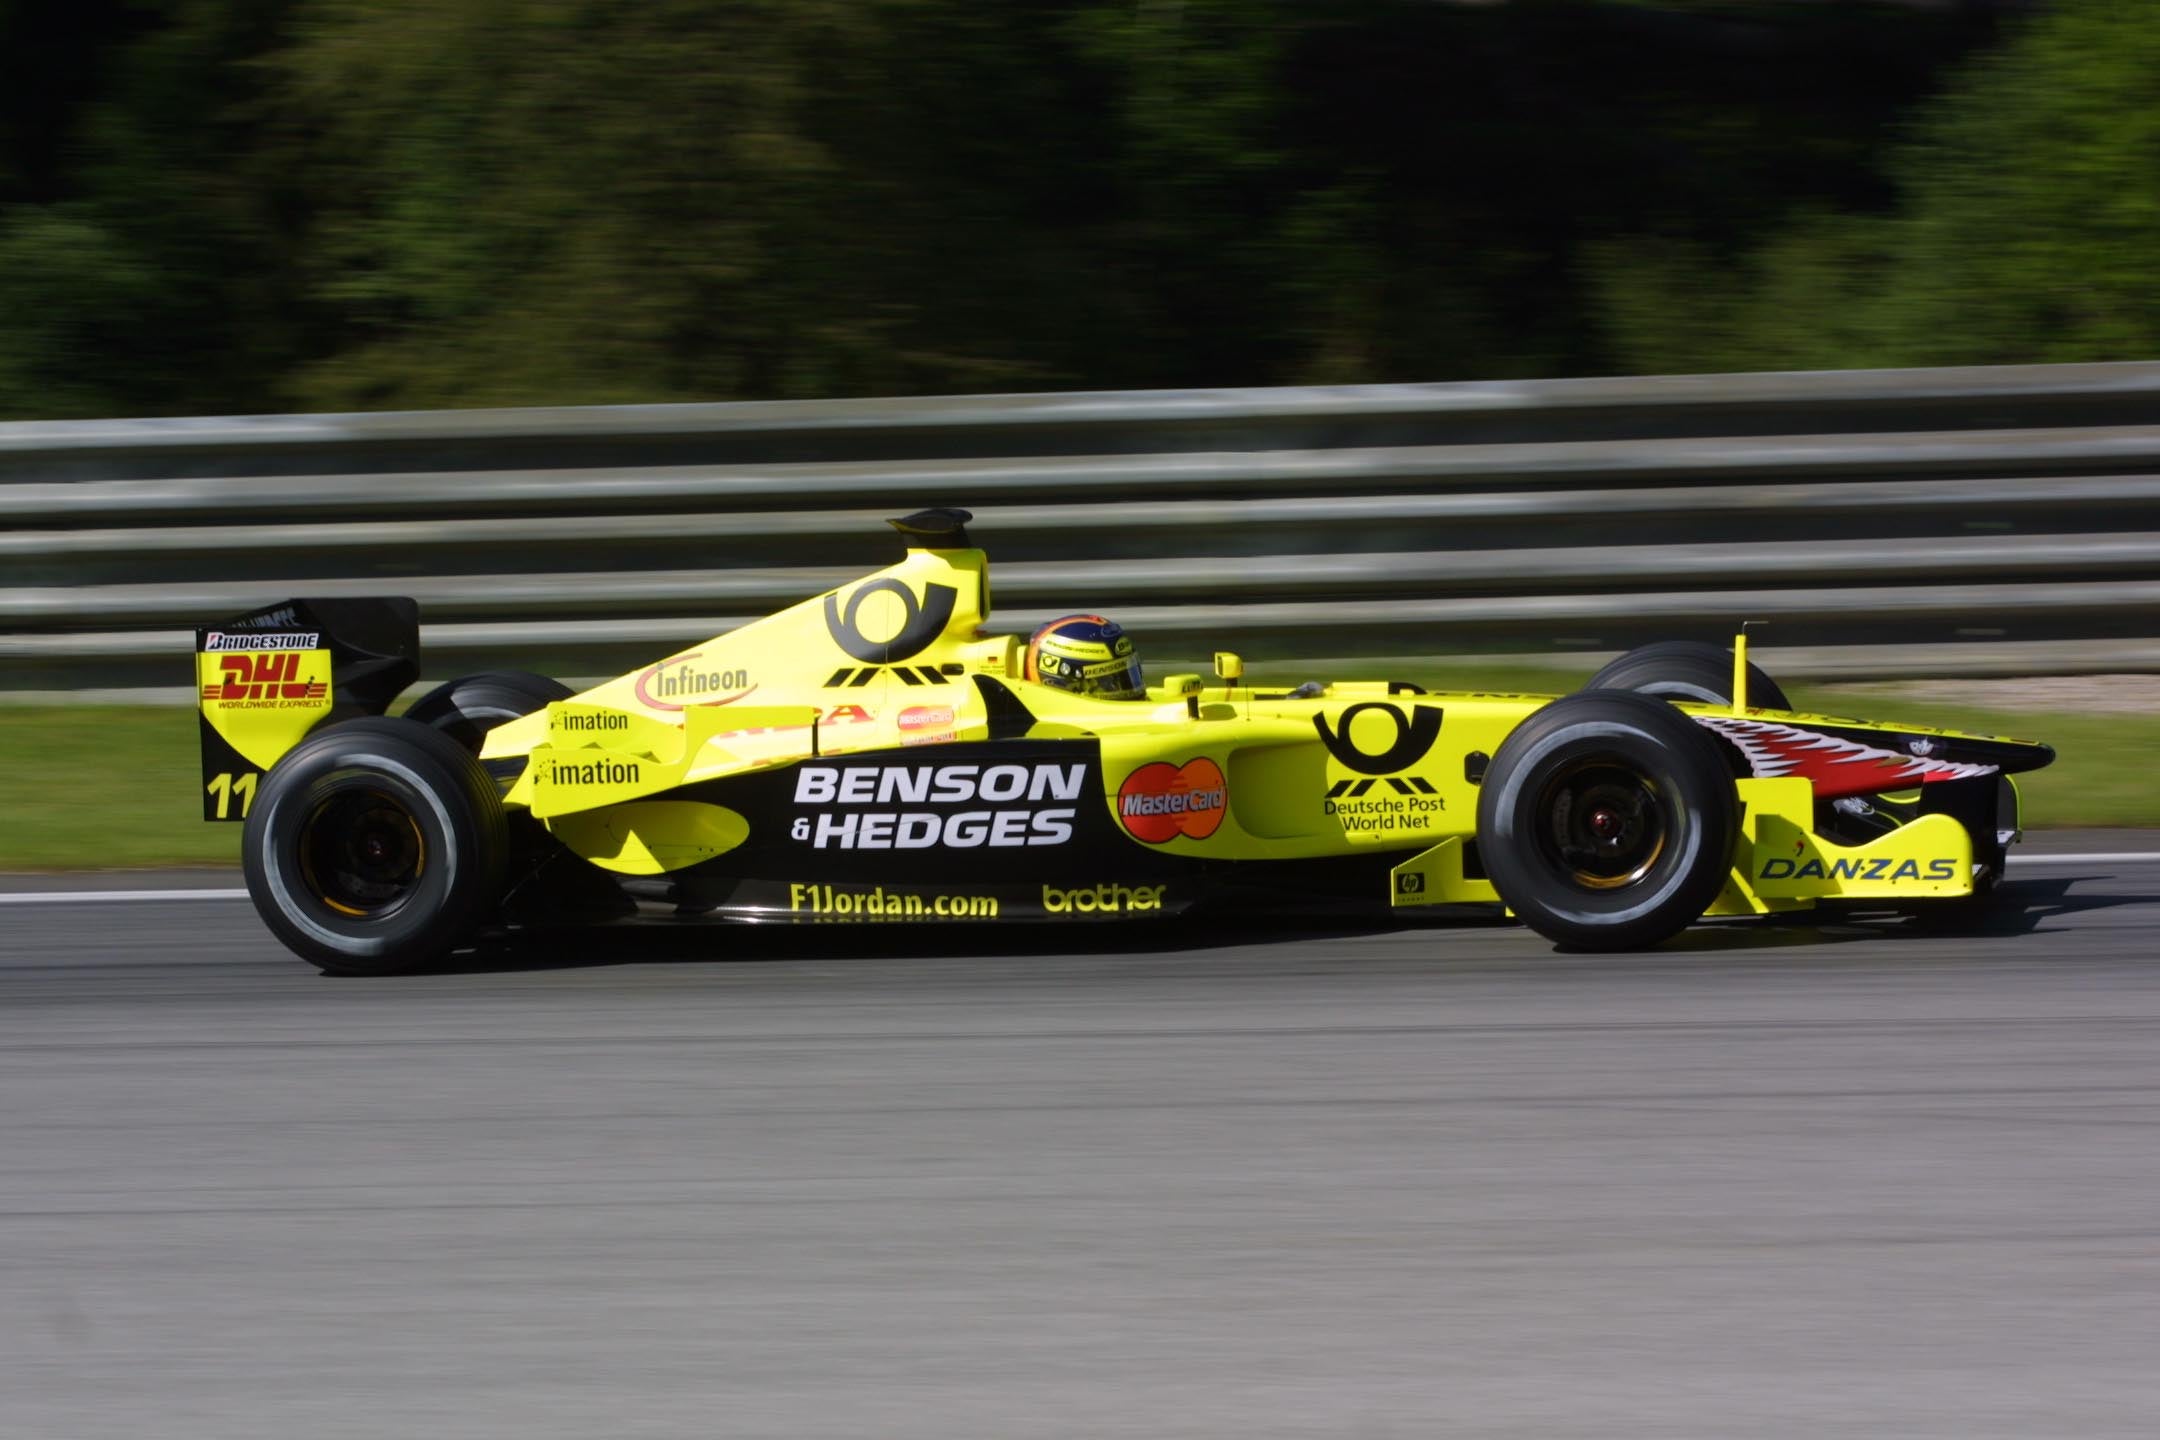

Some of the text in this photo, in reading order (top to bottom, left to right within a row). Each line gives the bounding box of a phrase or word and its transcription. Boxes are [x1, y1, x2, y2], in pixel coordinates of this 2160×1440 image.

[207, 633, 318, 650] BRIDGESTONE
[220, 653, 309, 700] DHL
[218, 699, 323, 709] WORLDWIDE EXPRESS
[563, 710, 628, 730] imation
[552, 758, 639, 785] imation
[793, 763, 1087, 804] BENSON
[207, 772, 258, 819] 11
[1123, 787, 1224, 816] MasterCard
[1324, 796, 1446, 816] Deutsche Post
[791, 808, 1076, 849] & HEDGES
[1342, 814, 1430, 831] World Net
[1759, 858, 1957, 881] DANZAS
[790, 883, 998, 917] F1Jordan.com
[1043, 883, 1166, 913] brother
